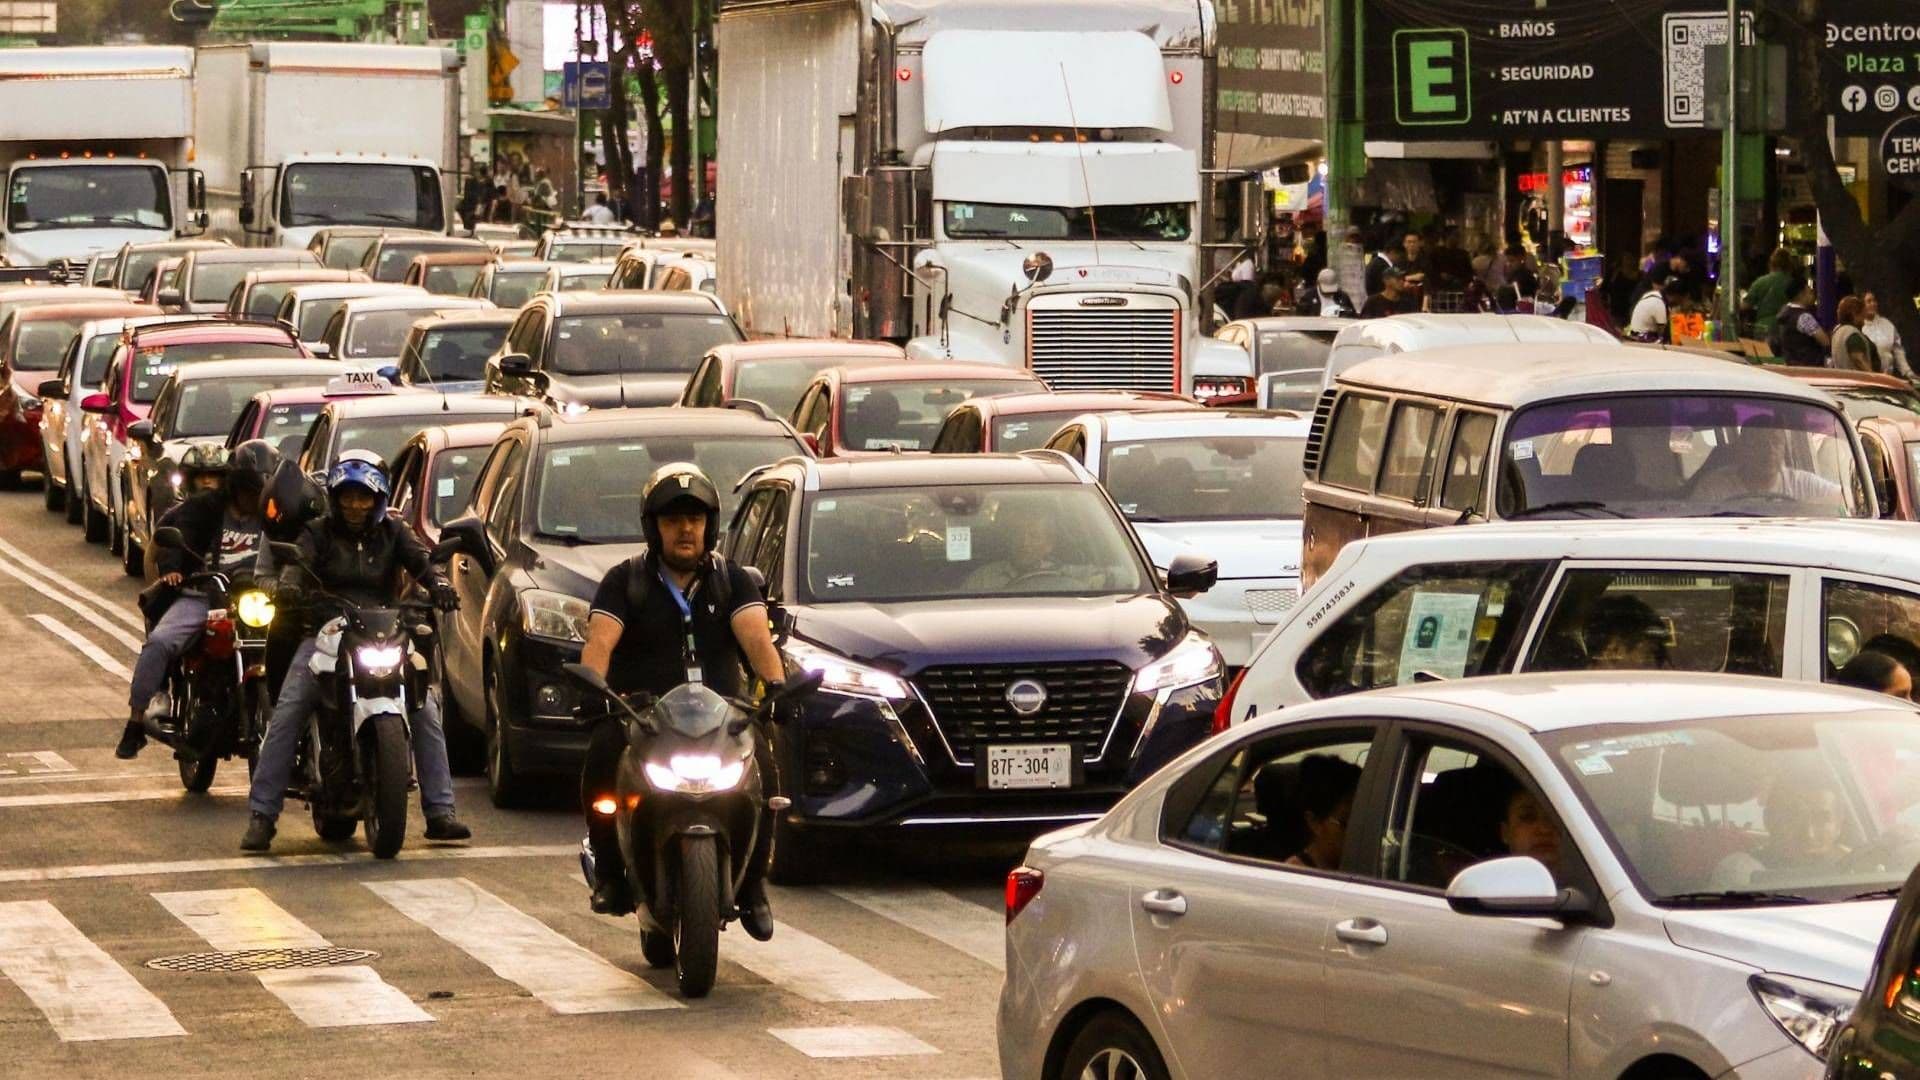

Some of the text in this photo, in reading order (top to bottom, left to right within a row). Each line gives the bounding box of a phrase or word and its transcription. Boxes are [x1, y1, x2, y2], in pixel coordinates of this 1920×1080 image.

[1499, 20, 1556, 38] BAÑOS
[1825, 22, 1920, 48] @centro
[1846, 52, 1905, 72] Plaza
[1409, 41, 1457, 112] E
[1501, 65, 1594, 81] SEGURIDAD
[1542, 109, 1554, 124] A
[1556, 107, 1631, 123] CLIENTES
[345, 372, 373, 384] TAXI
[991, 757, 1049, 776] 87F-304
